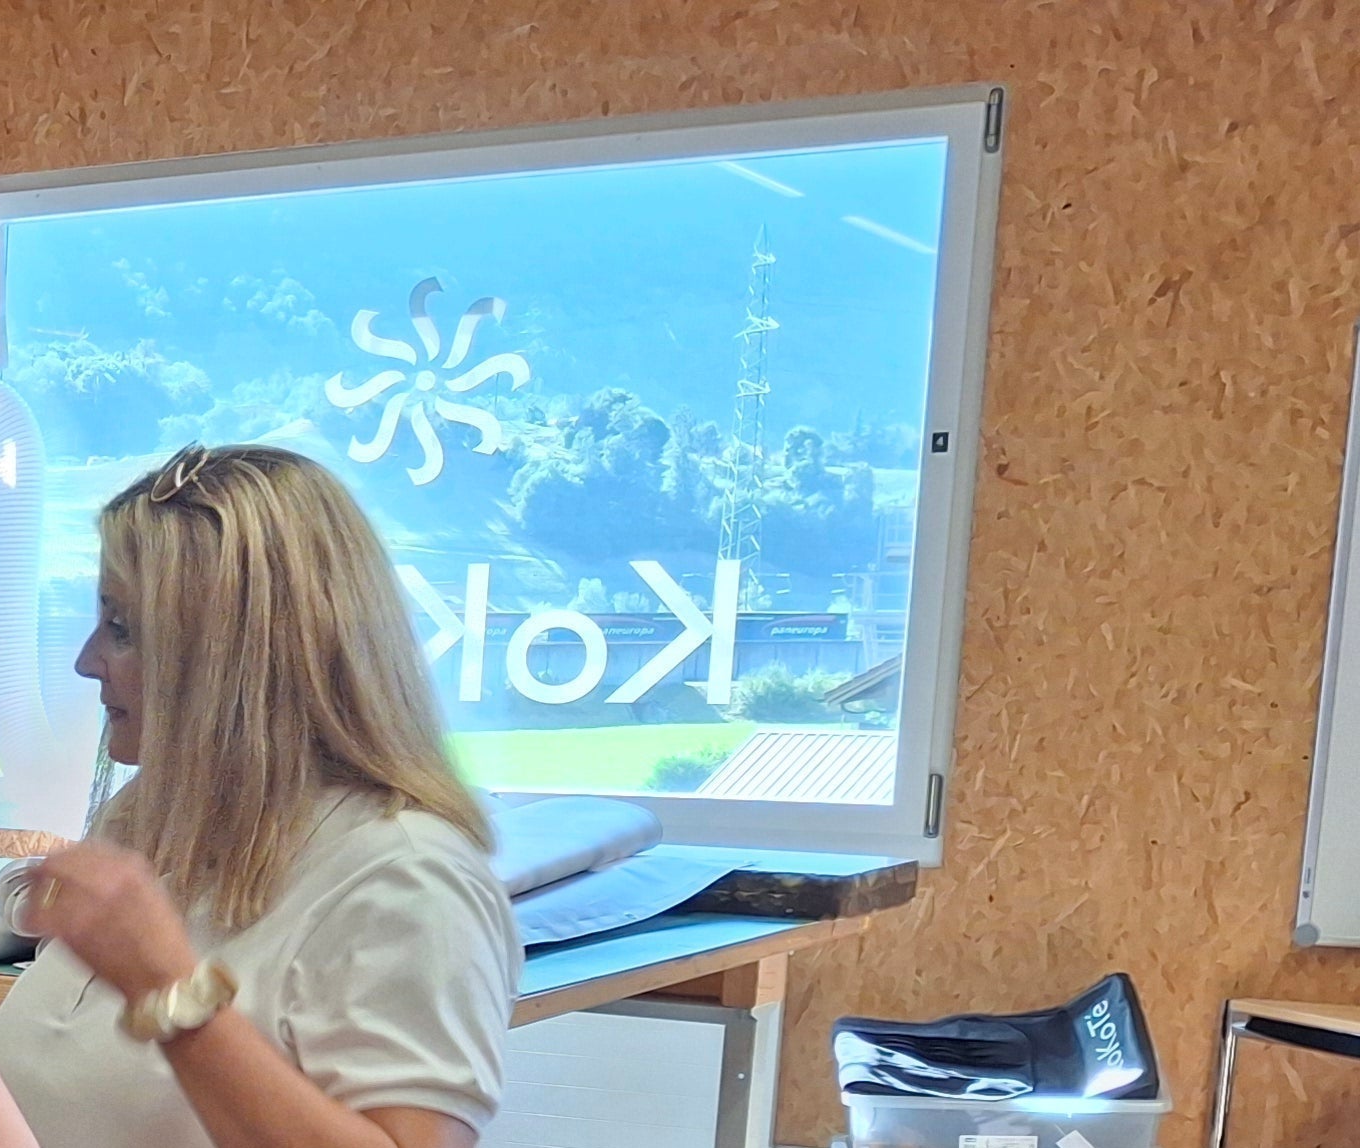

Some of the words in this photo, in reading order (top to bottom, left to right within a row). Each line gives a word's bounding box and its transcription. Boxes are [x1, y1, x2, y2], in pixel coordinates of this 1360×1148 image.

[602, 627, 655, 637] aneuropa
[770, 626, 828, 636] paneuropa
[1084, 1000, 1124, 1069] oKoTé
